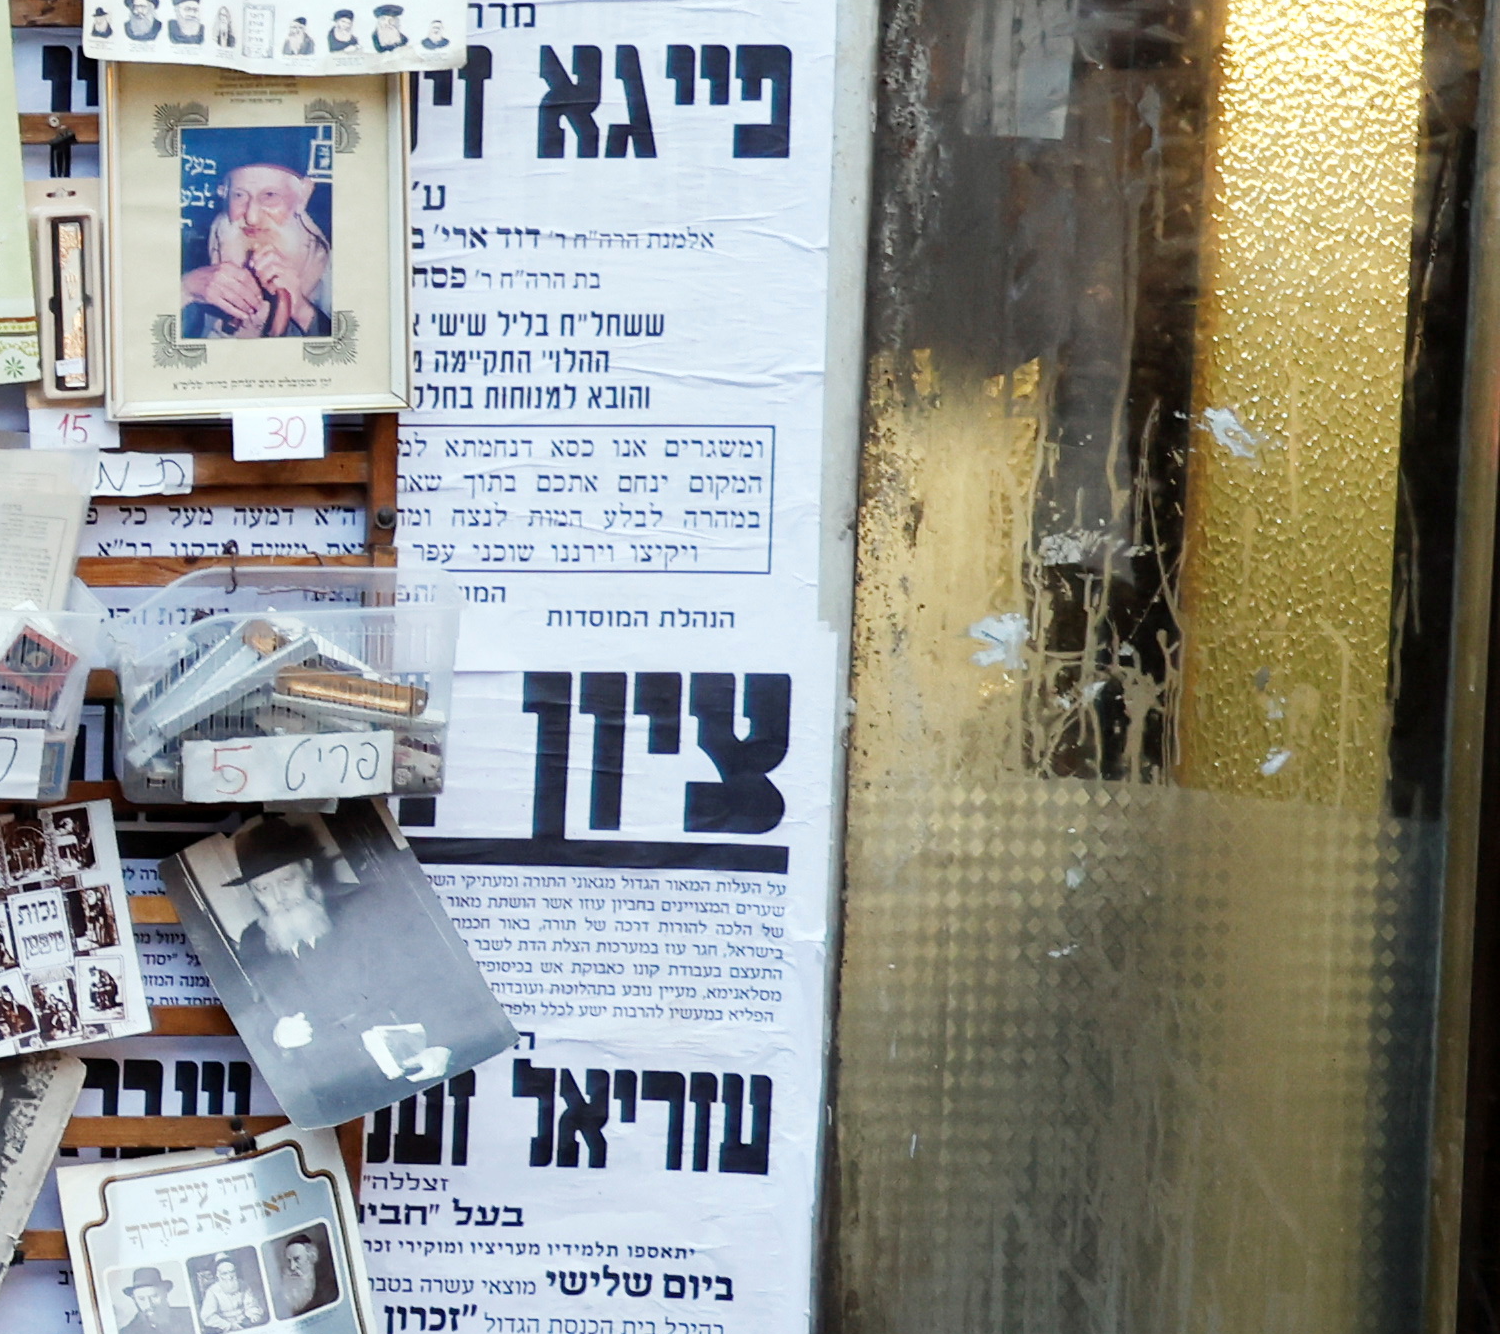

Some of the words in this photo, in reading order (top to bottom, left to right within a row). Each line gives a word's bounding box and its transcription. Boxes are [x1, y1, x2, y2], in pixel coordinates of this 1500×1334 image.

[536, 44, 793, 159] פייגא
[57, 414, 92, 445] 15
[263, 416, 307, 449] 30
[546, 609, 649, 628] המוסדות
[658, 608, 735, 629] הנהלת
[522, 670, 793, 839] ציון
[212, 745, 254, 795] 5
[460, 874, 519, 892] ומעתיקי
[522, 875, 567, 889] התורה
[570, 875, 616, 890] מגאוני
[620, 874, 660, 891] הגדול
[664, 879, 711, 893] המאור
[715, 877, 762, 895] העלות
[766, 880, 787, 897] על
[512, 1058, 773, 1176] עזריאל
[420, 1278, 474, 1295] עשרה
[481, 1280, 536, 1296] מוצאי
[545, 1264, 653, 1298] שלישי
[663, 1273, 734, 1302] ביום
[484, 1312, 540, 1334] הגדול
